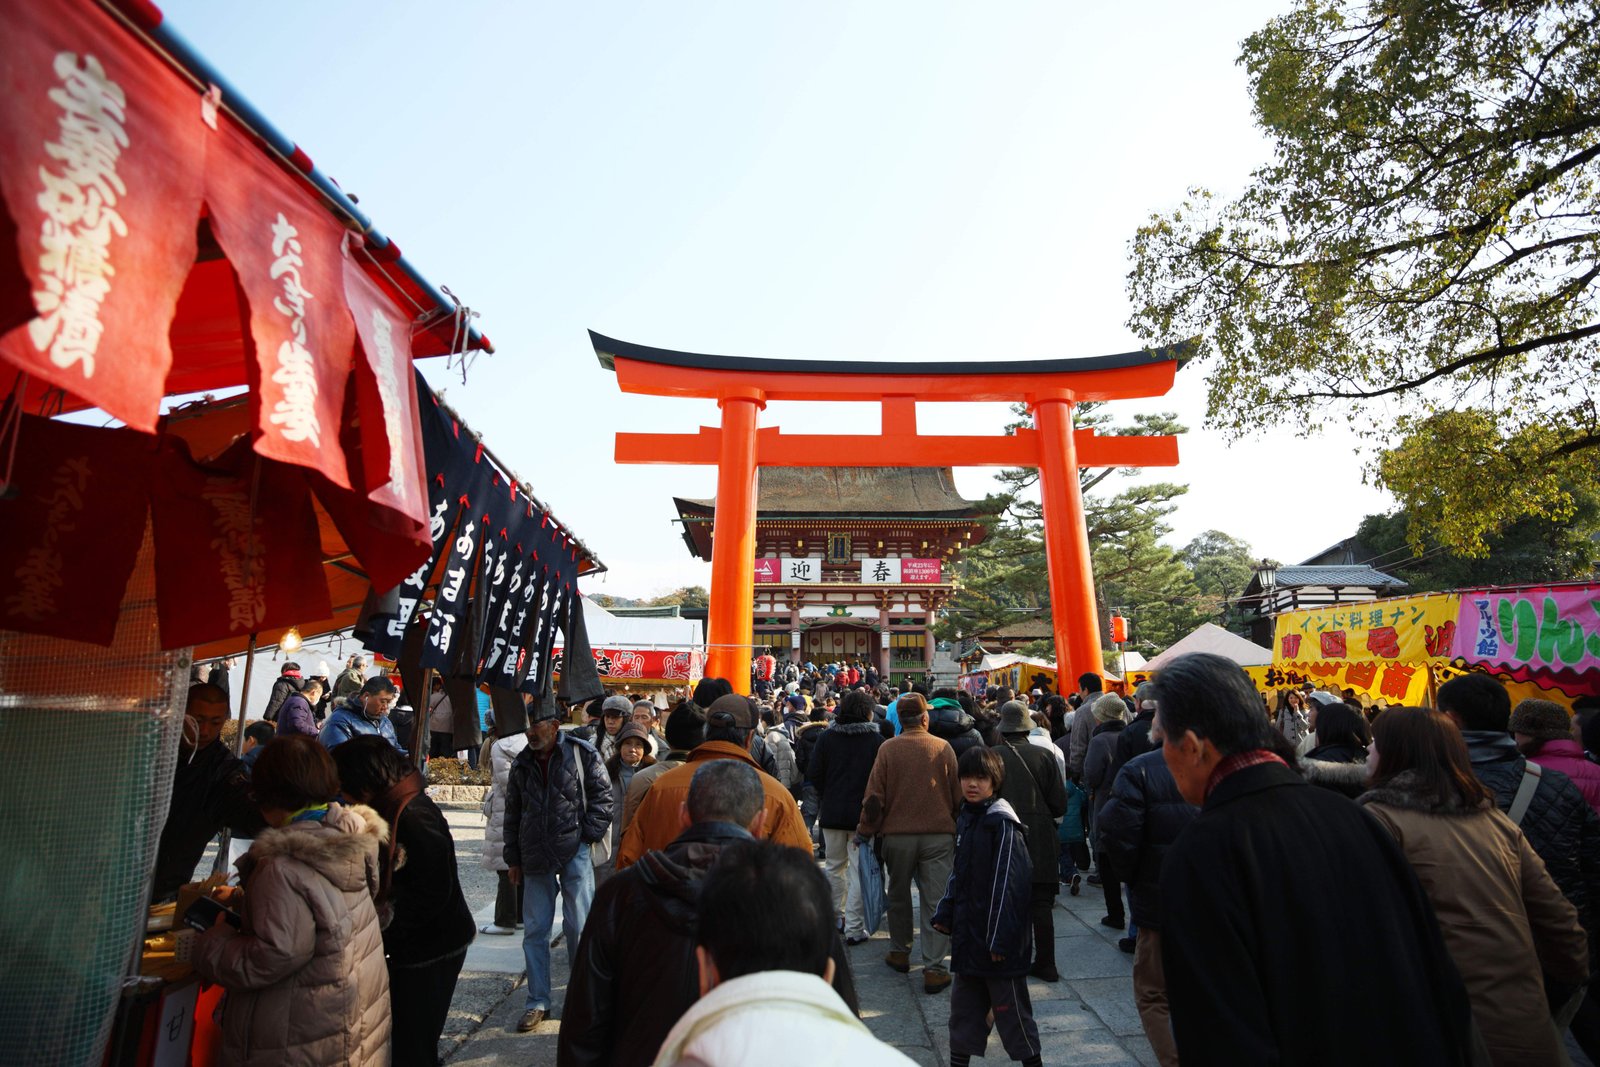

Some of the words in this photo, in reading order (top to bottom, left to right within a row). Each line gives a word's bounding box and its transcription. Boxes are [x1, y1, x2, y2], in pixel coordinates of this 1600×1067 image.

[430, 520, 475, 655] あま酒
[790, 560, 812, 581] 迎
[872, 560, 892, 582] 春
[1300, 606, 1425, 633] インド料理ナン
[1475, 600, 1499, 656] フルーツ飴
[1498, 596, 1600, 665] りん
